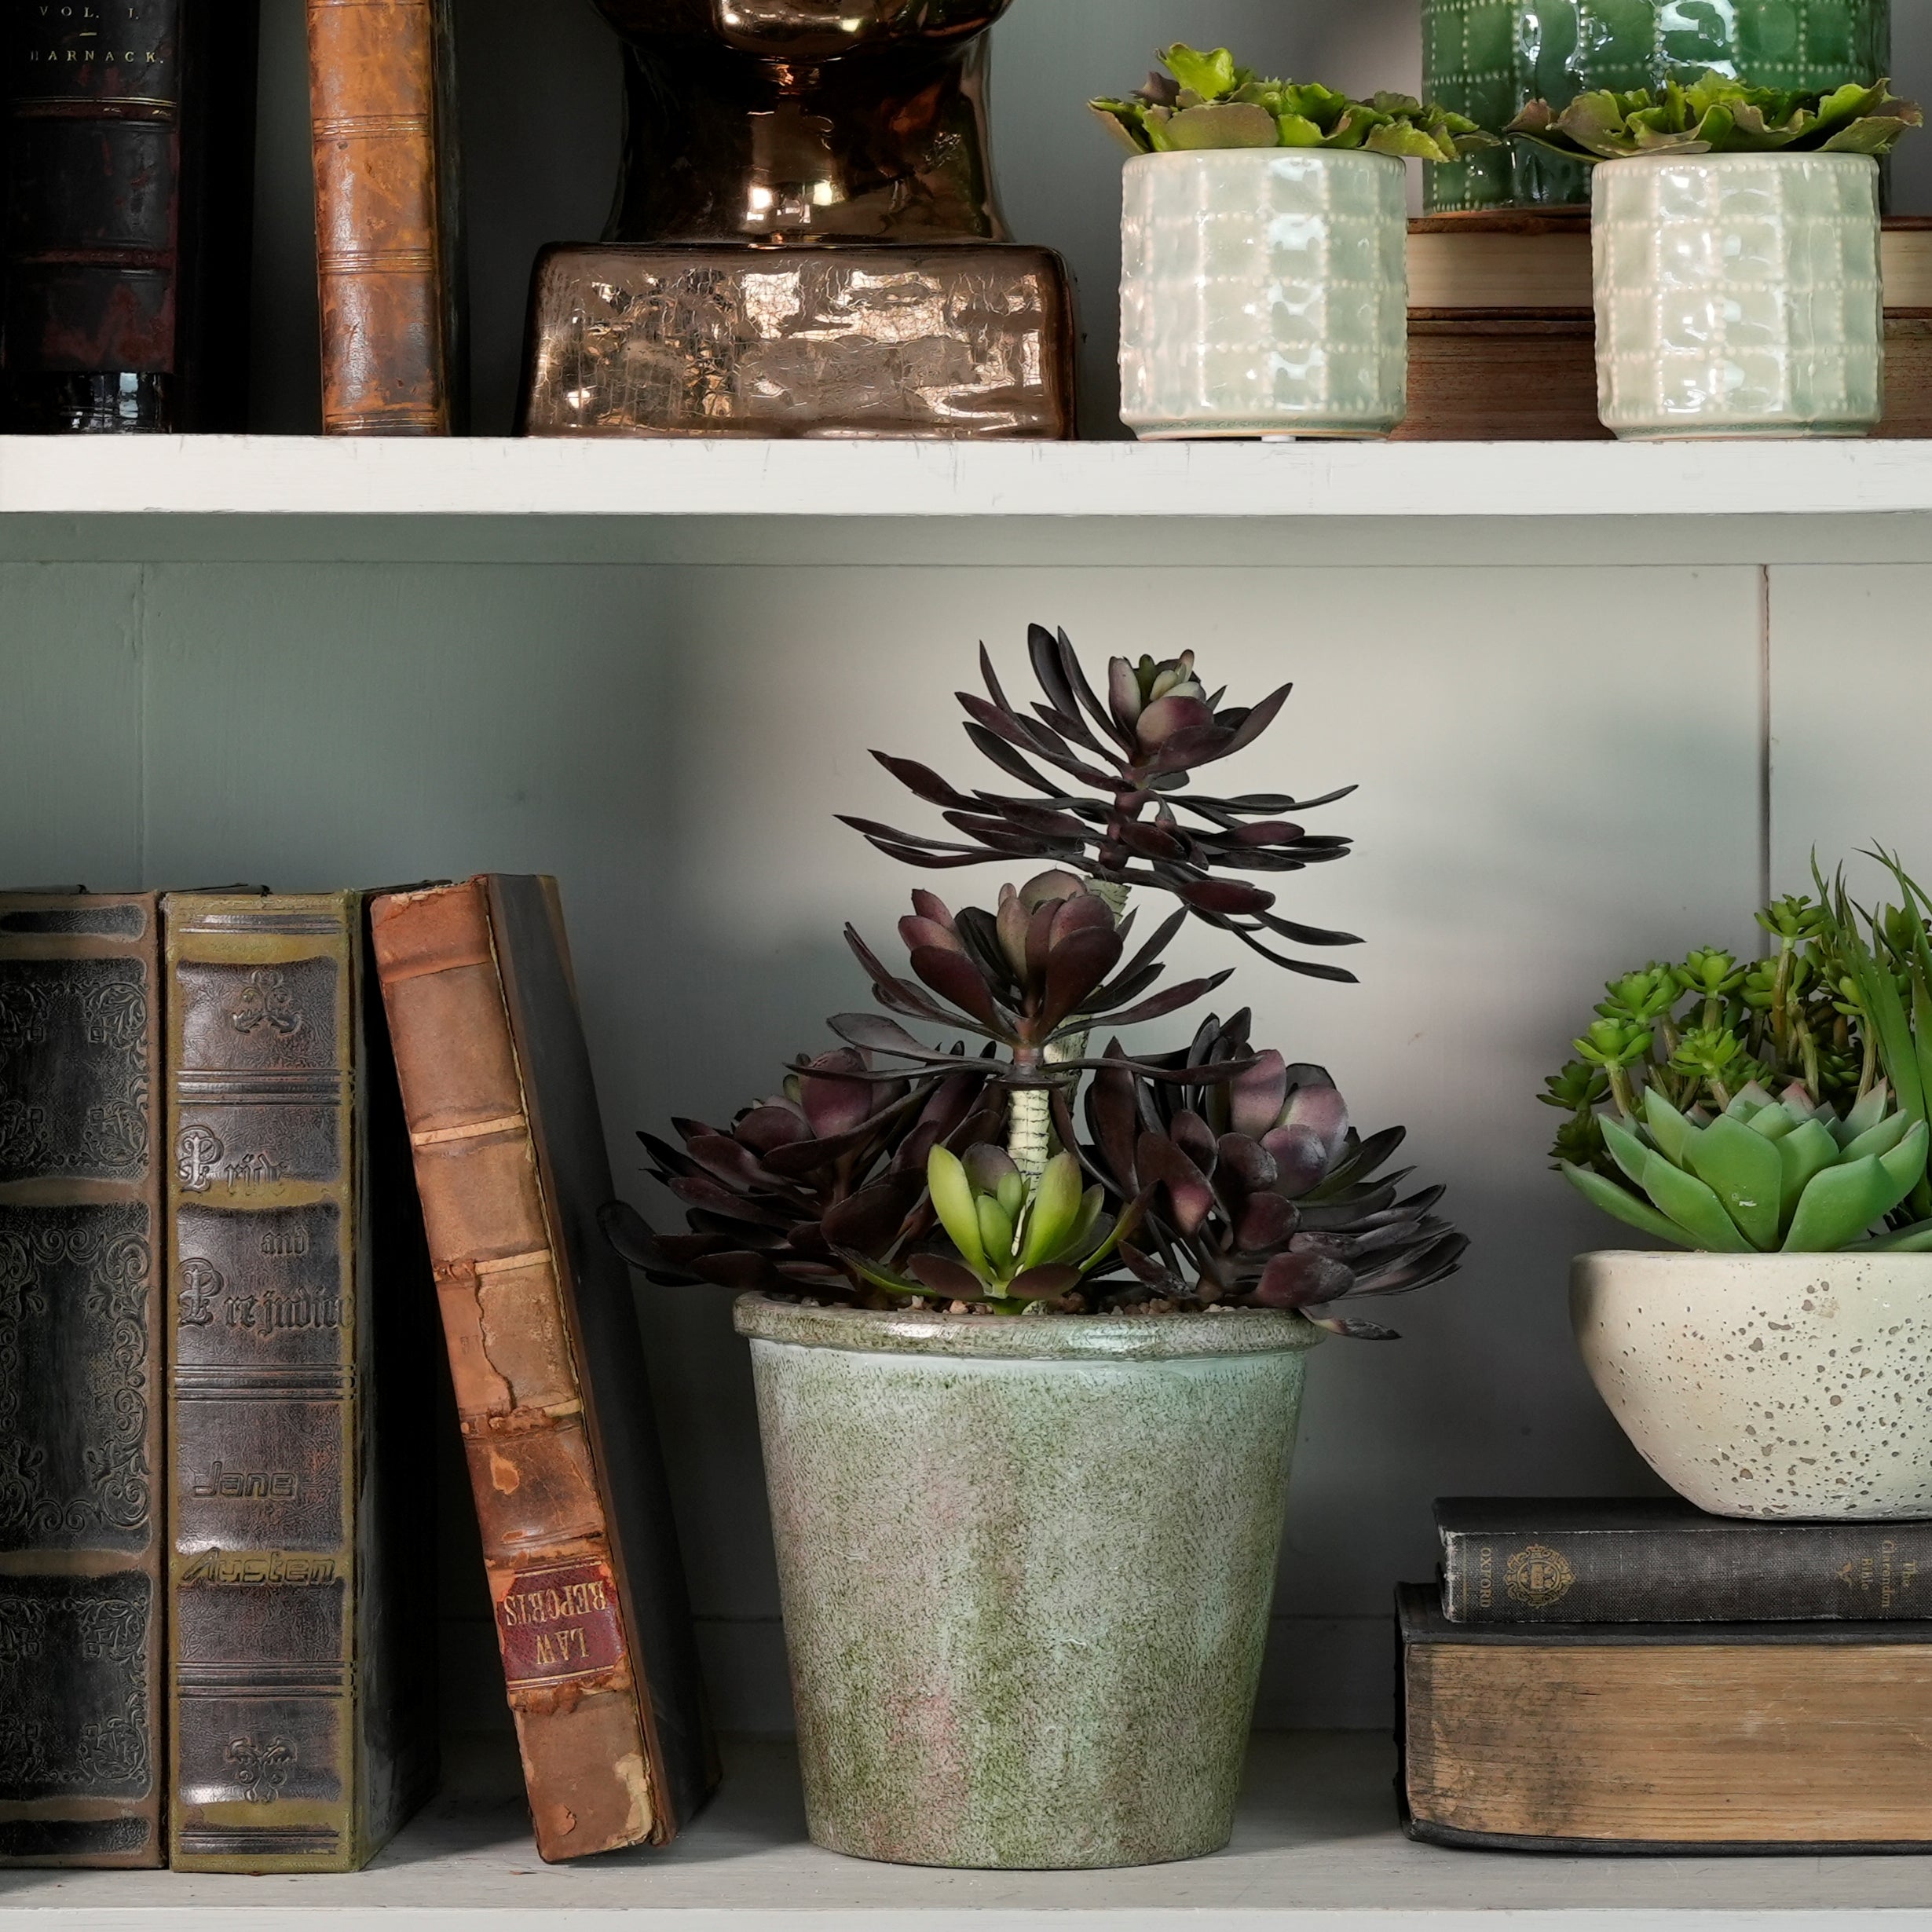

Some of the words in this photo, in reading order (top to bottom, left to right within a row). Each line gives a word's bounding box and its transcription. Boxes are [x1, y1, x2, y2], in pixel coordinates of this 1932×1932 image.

[39, 5, 101, 19] VOL.
[30, 49, 165, 64] HARNACK.
[261, 1225, 310, 1257] and
[192, 1461, 299, 1499] Jane
[181, 1546, 336, 1586] Austen
[1861, 1557, 1874, 1590] Bible
[1882, 1539, 1895, 1608] Clarendon
[1902, 1560, 1917, 1588] The
[503, 1580, 607, 1626] REPORTS
[536, 1627, 590, 1666] LAW
